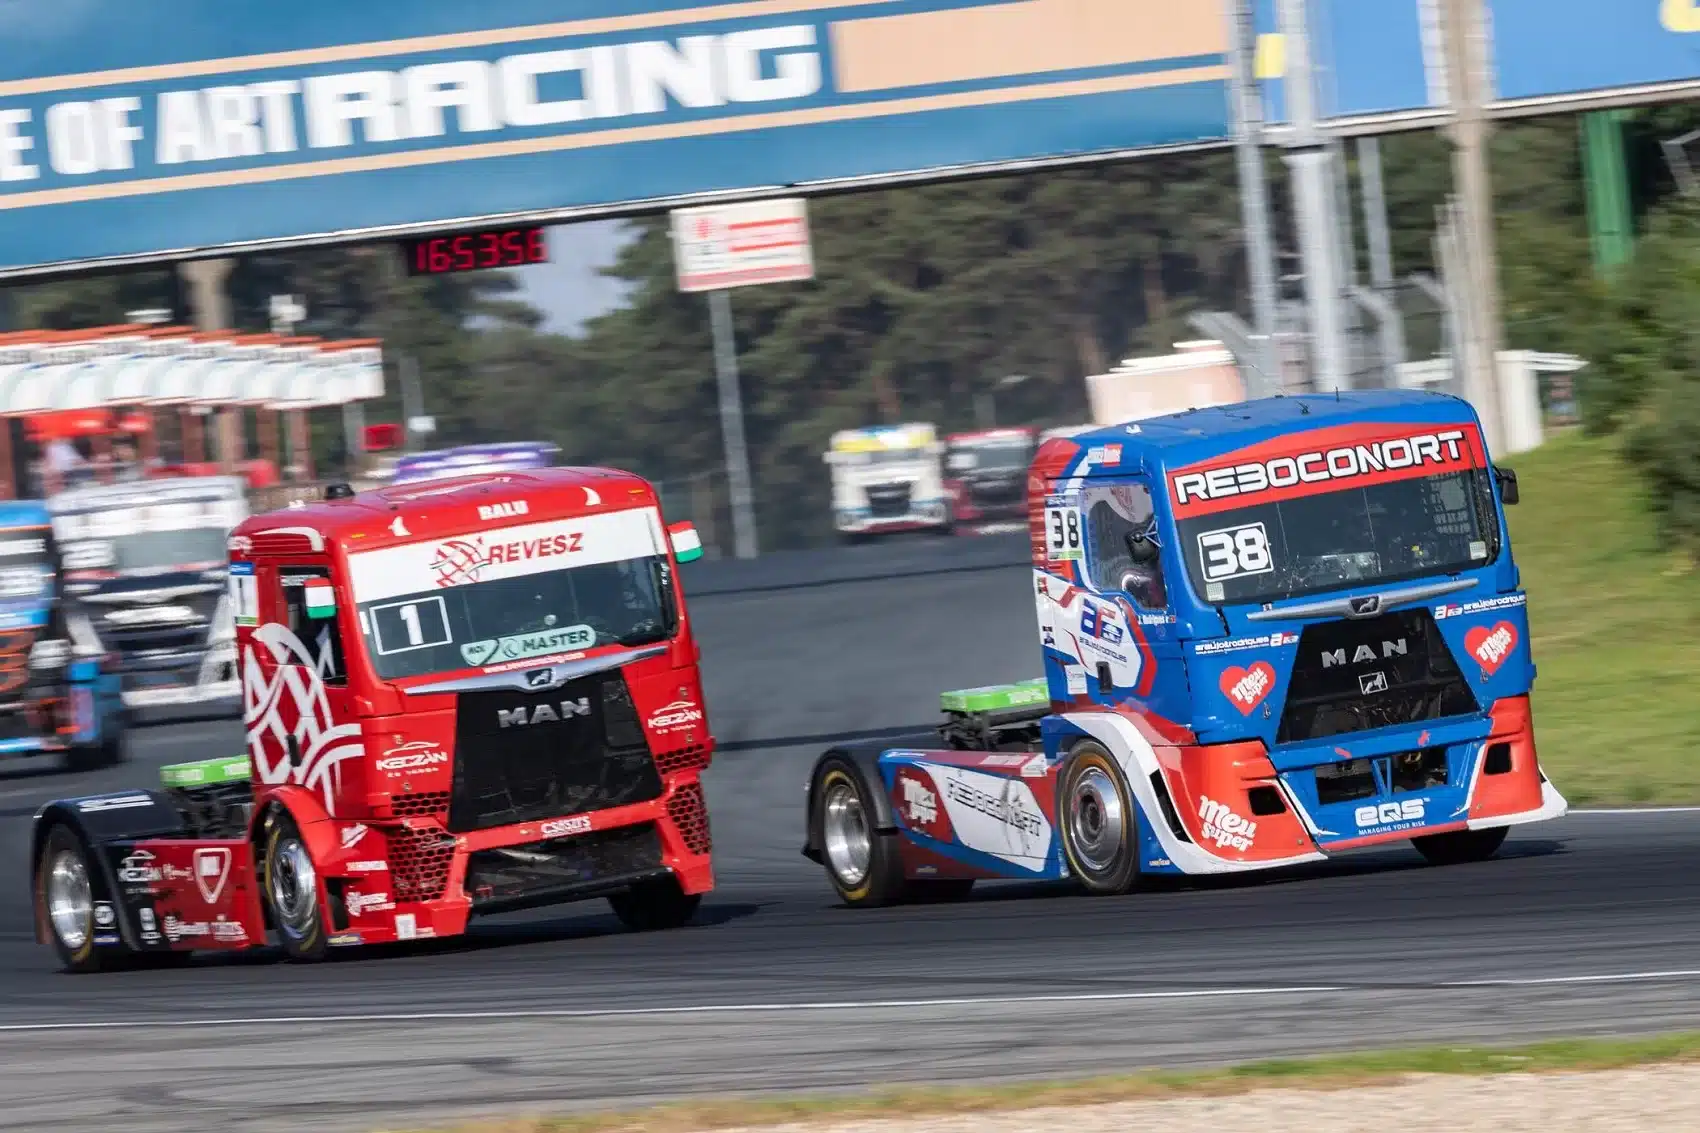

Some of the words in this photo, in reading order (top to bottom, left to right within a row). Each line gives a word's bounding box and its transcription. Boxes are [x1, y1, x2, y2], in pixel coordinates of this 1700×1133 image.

[45, 97, 144, 175] OF
[155, 80, 300, 164] ART
[300, 25, 822, 149] RACING
[1174, 431, 1464, 504] REBOCONORT
[1050, 510, 1079, 549] 38
[1202, 528, 1269, 578] 38
[400, 604, 424, 646] 1
[522, 630, 588, 652] MASTER
[1321, 638, 1408, 668] MAN
[497, 698, 592, 728] MAN
[1358, 826, 1392, 836] MANAGING
[1393, 822, 1410, 831] YOUR
[1411, 820, 1426, 829] RISK
